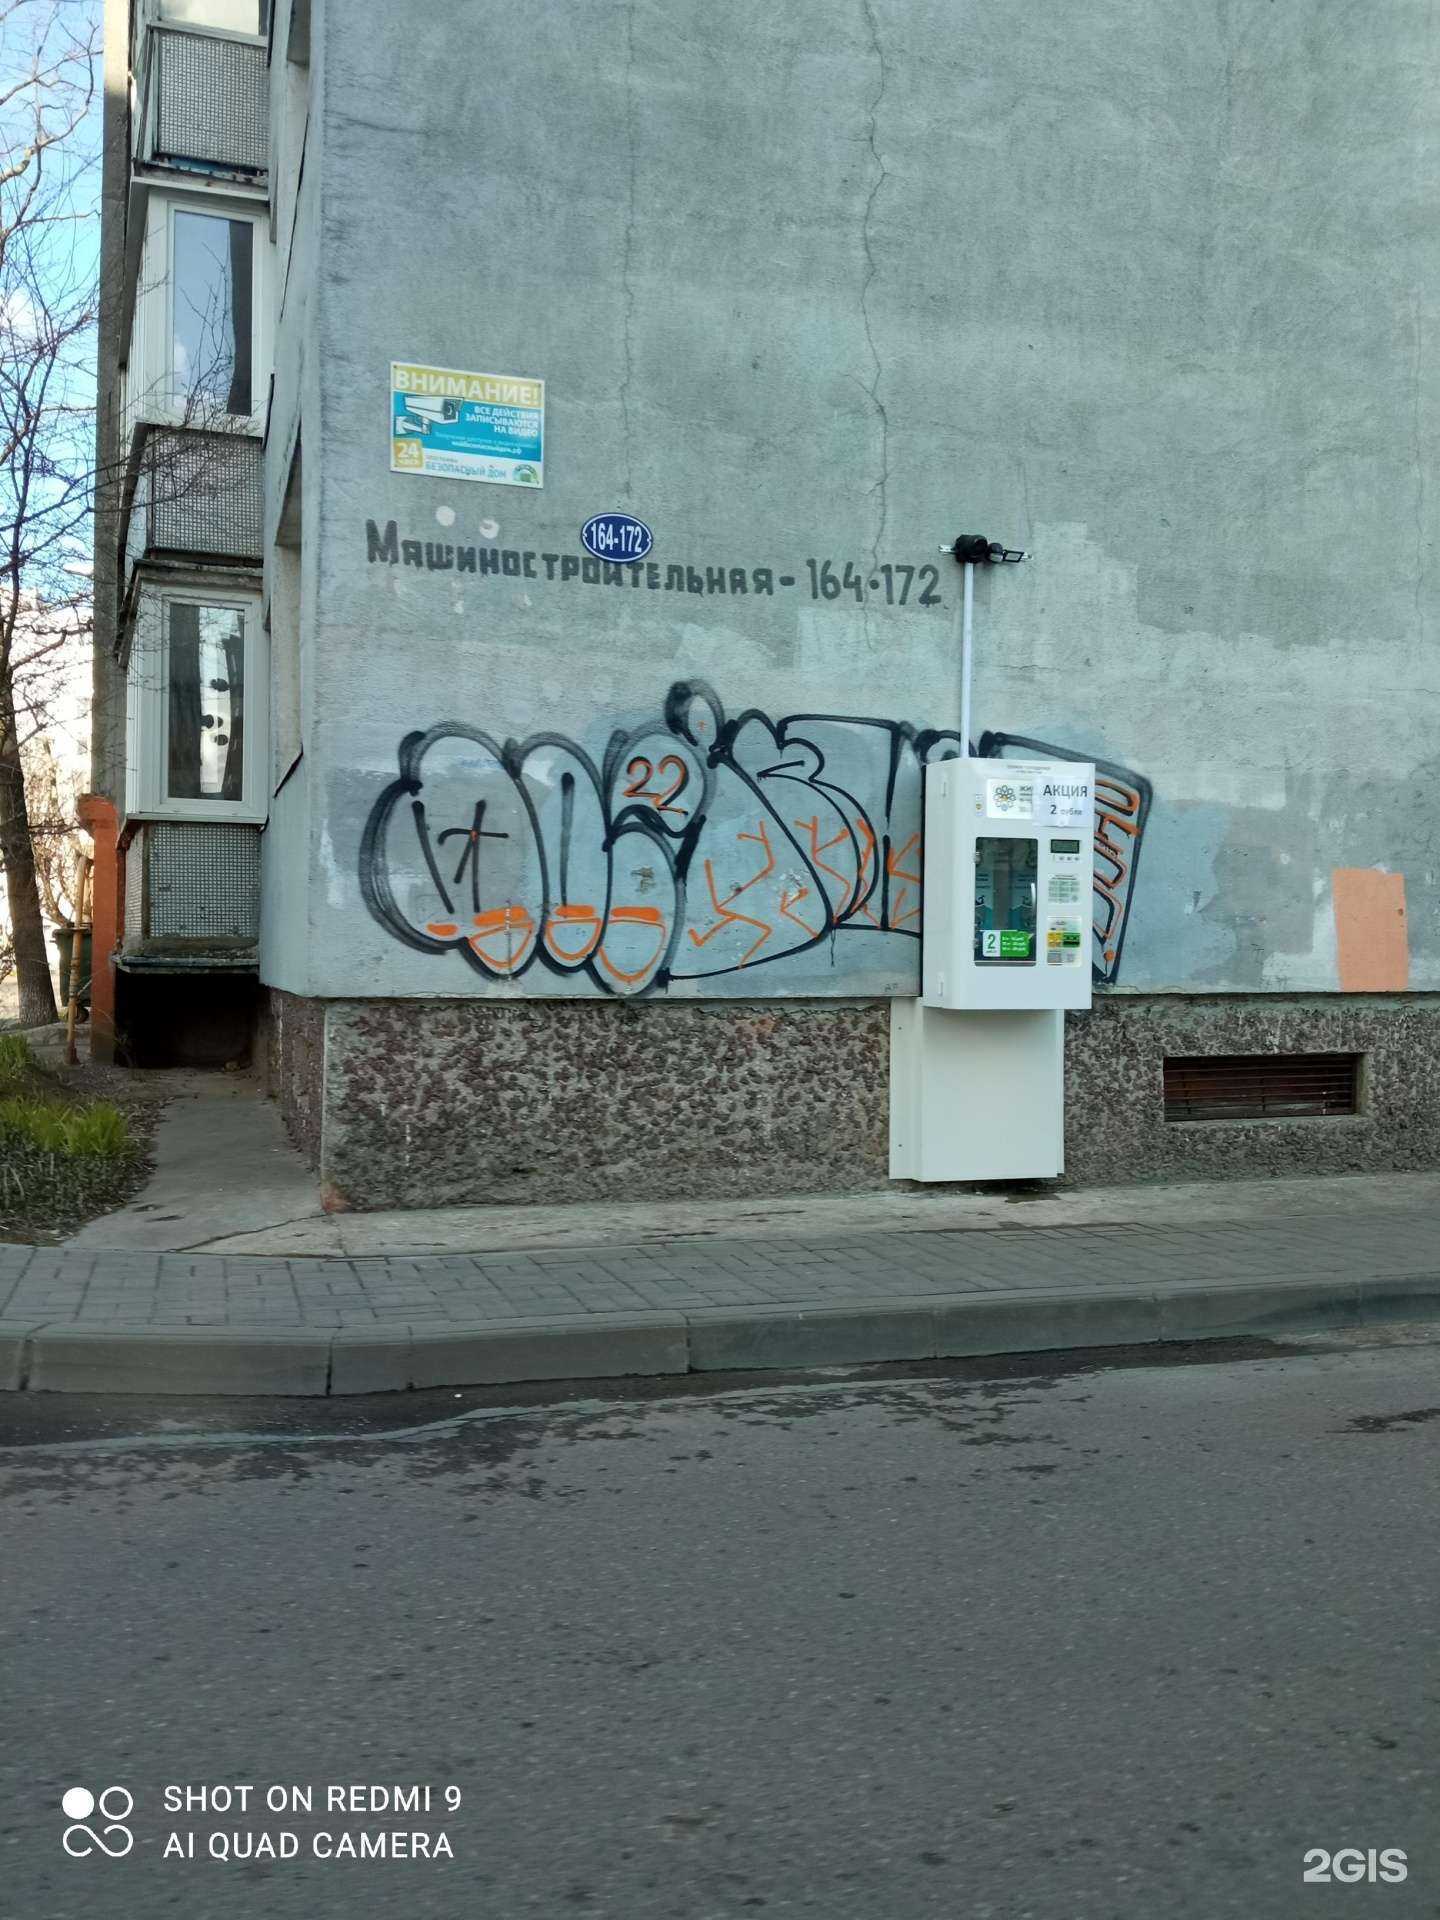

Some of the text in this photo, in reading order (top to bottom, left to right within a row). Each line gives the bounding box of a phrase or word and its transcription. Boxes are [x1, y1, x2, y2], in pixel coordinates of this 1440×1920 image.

[395, 370, 539, 406] ВНИМАНИЕ!
[474, 405, 491, 415] ВСЕ
[494, 424, 507, 434] НА
[397, 442, 418, 458] 24
[590, 522, 643, 553] 164-172
[1042, 784, 1088, 799] АКЦИЯ
[1050, 804, 1057, 815] 2
[987, 933, 996, 949] 2
